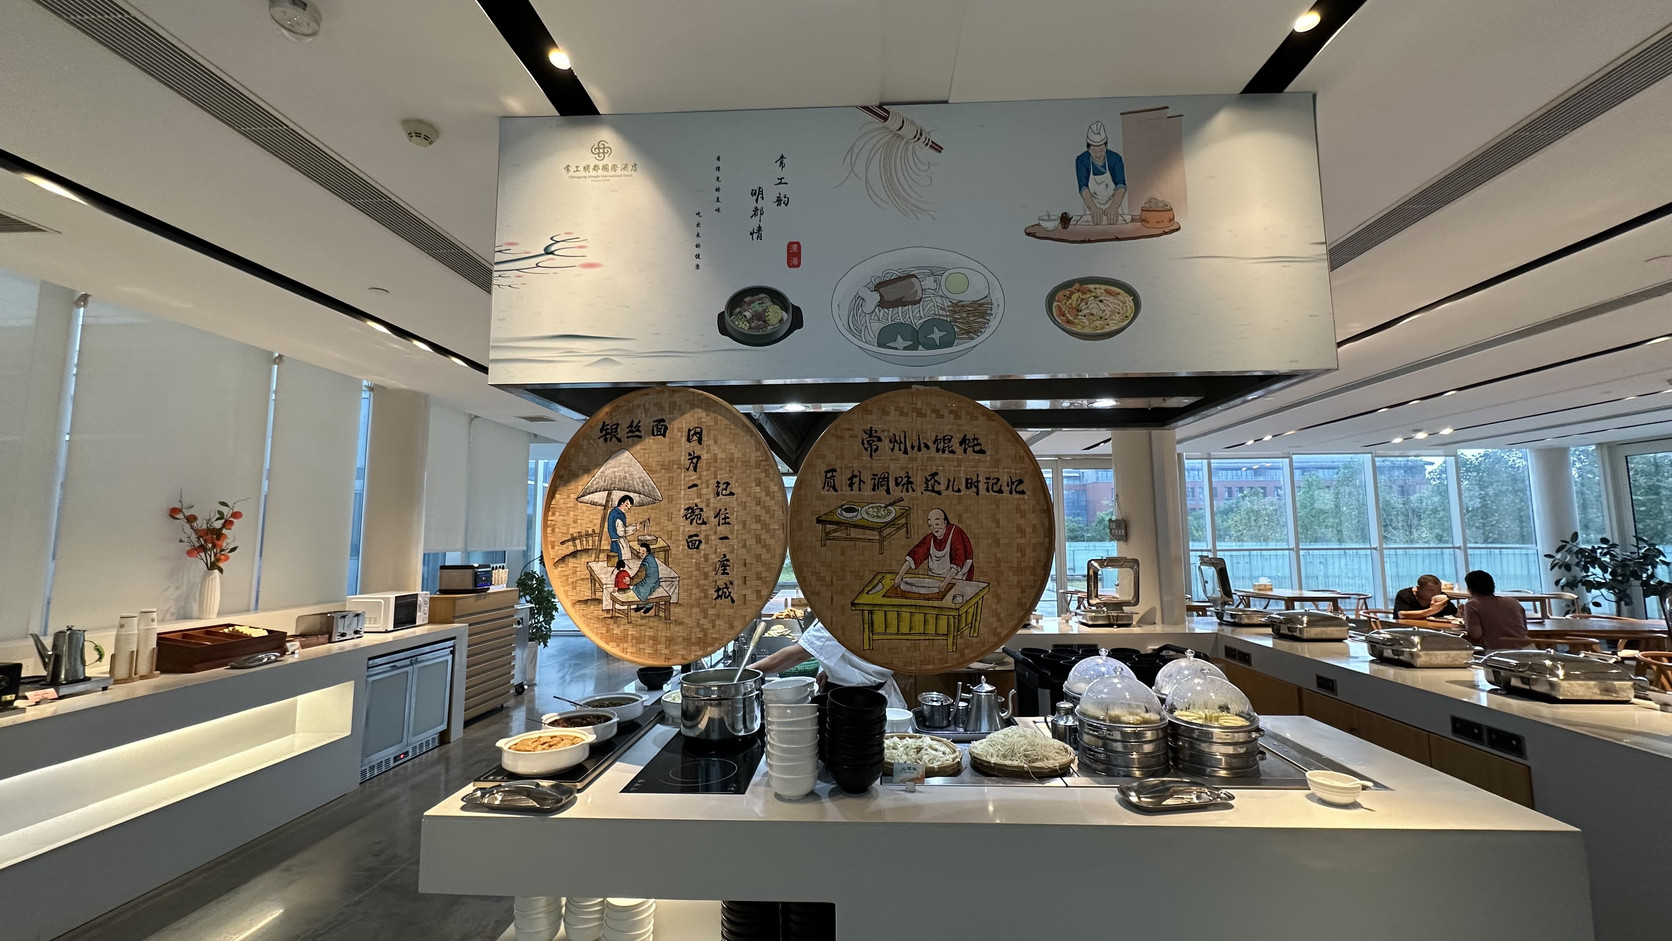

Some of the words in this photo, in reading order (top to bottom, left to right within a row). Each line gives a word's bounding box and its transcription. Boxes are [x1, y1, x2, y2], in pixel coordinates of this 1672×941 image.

[773, 153, 790, 207] 常工韵
[749, 186, 765, 241] 明都情
[598, 417, 669, 443] 银丝面
[860, 426, 987, 459] 常州小馄饨
[682, 426, 707, 550] 因为一碗面
[713, 480, 736, 604] 记住一座城
